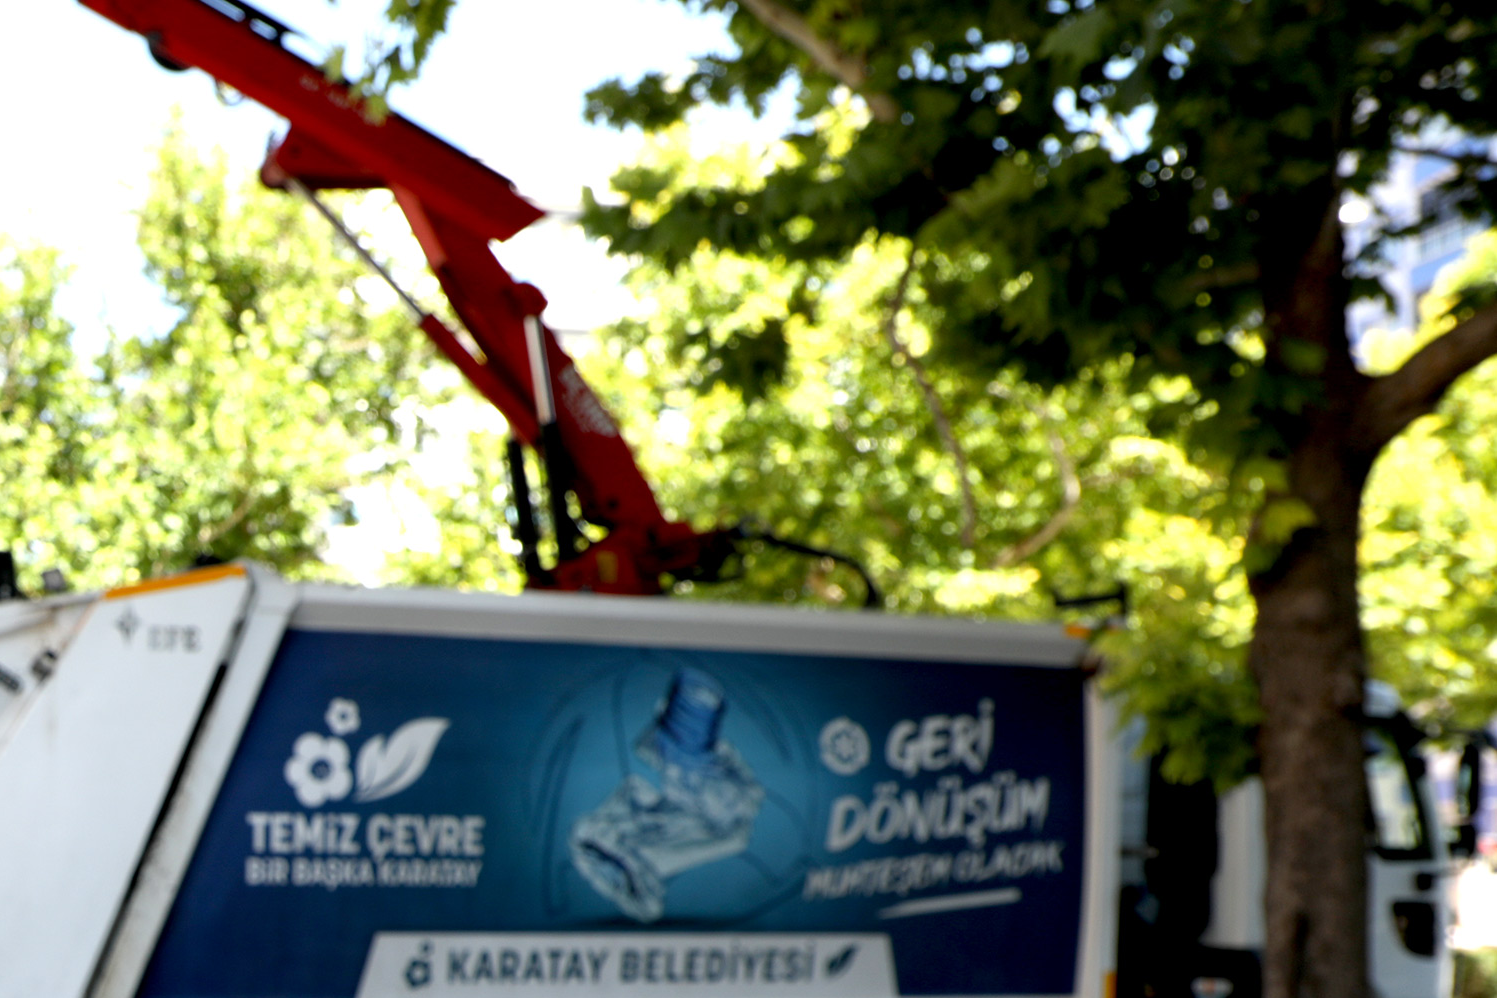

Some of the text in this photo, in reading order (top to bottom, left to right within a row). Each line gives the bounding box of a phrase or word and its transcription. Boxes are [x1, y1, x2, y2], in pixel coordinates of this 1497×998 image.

[885, 698, 995, 777] GERİ
[826, 770, 1050, 851] DÖNÜŞÜM
[246, 811, 486, 860] TEMİZ ÇEVRE
[292, 857, 375, 890] BAŞKA
[446, 939, 816, 985] KARATAY BELEDİYESİ
